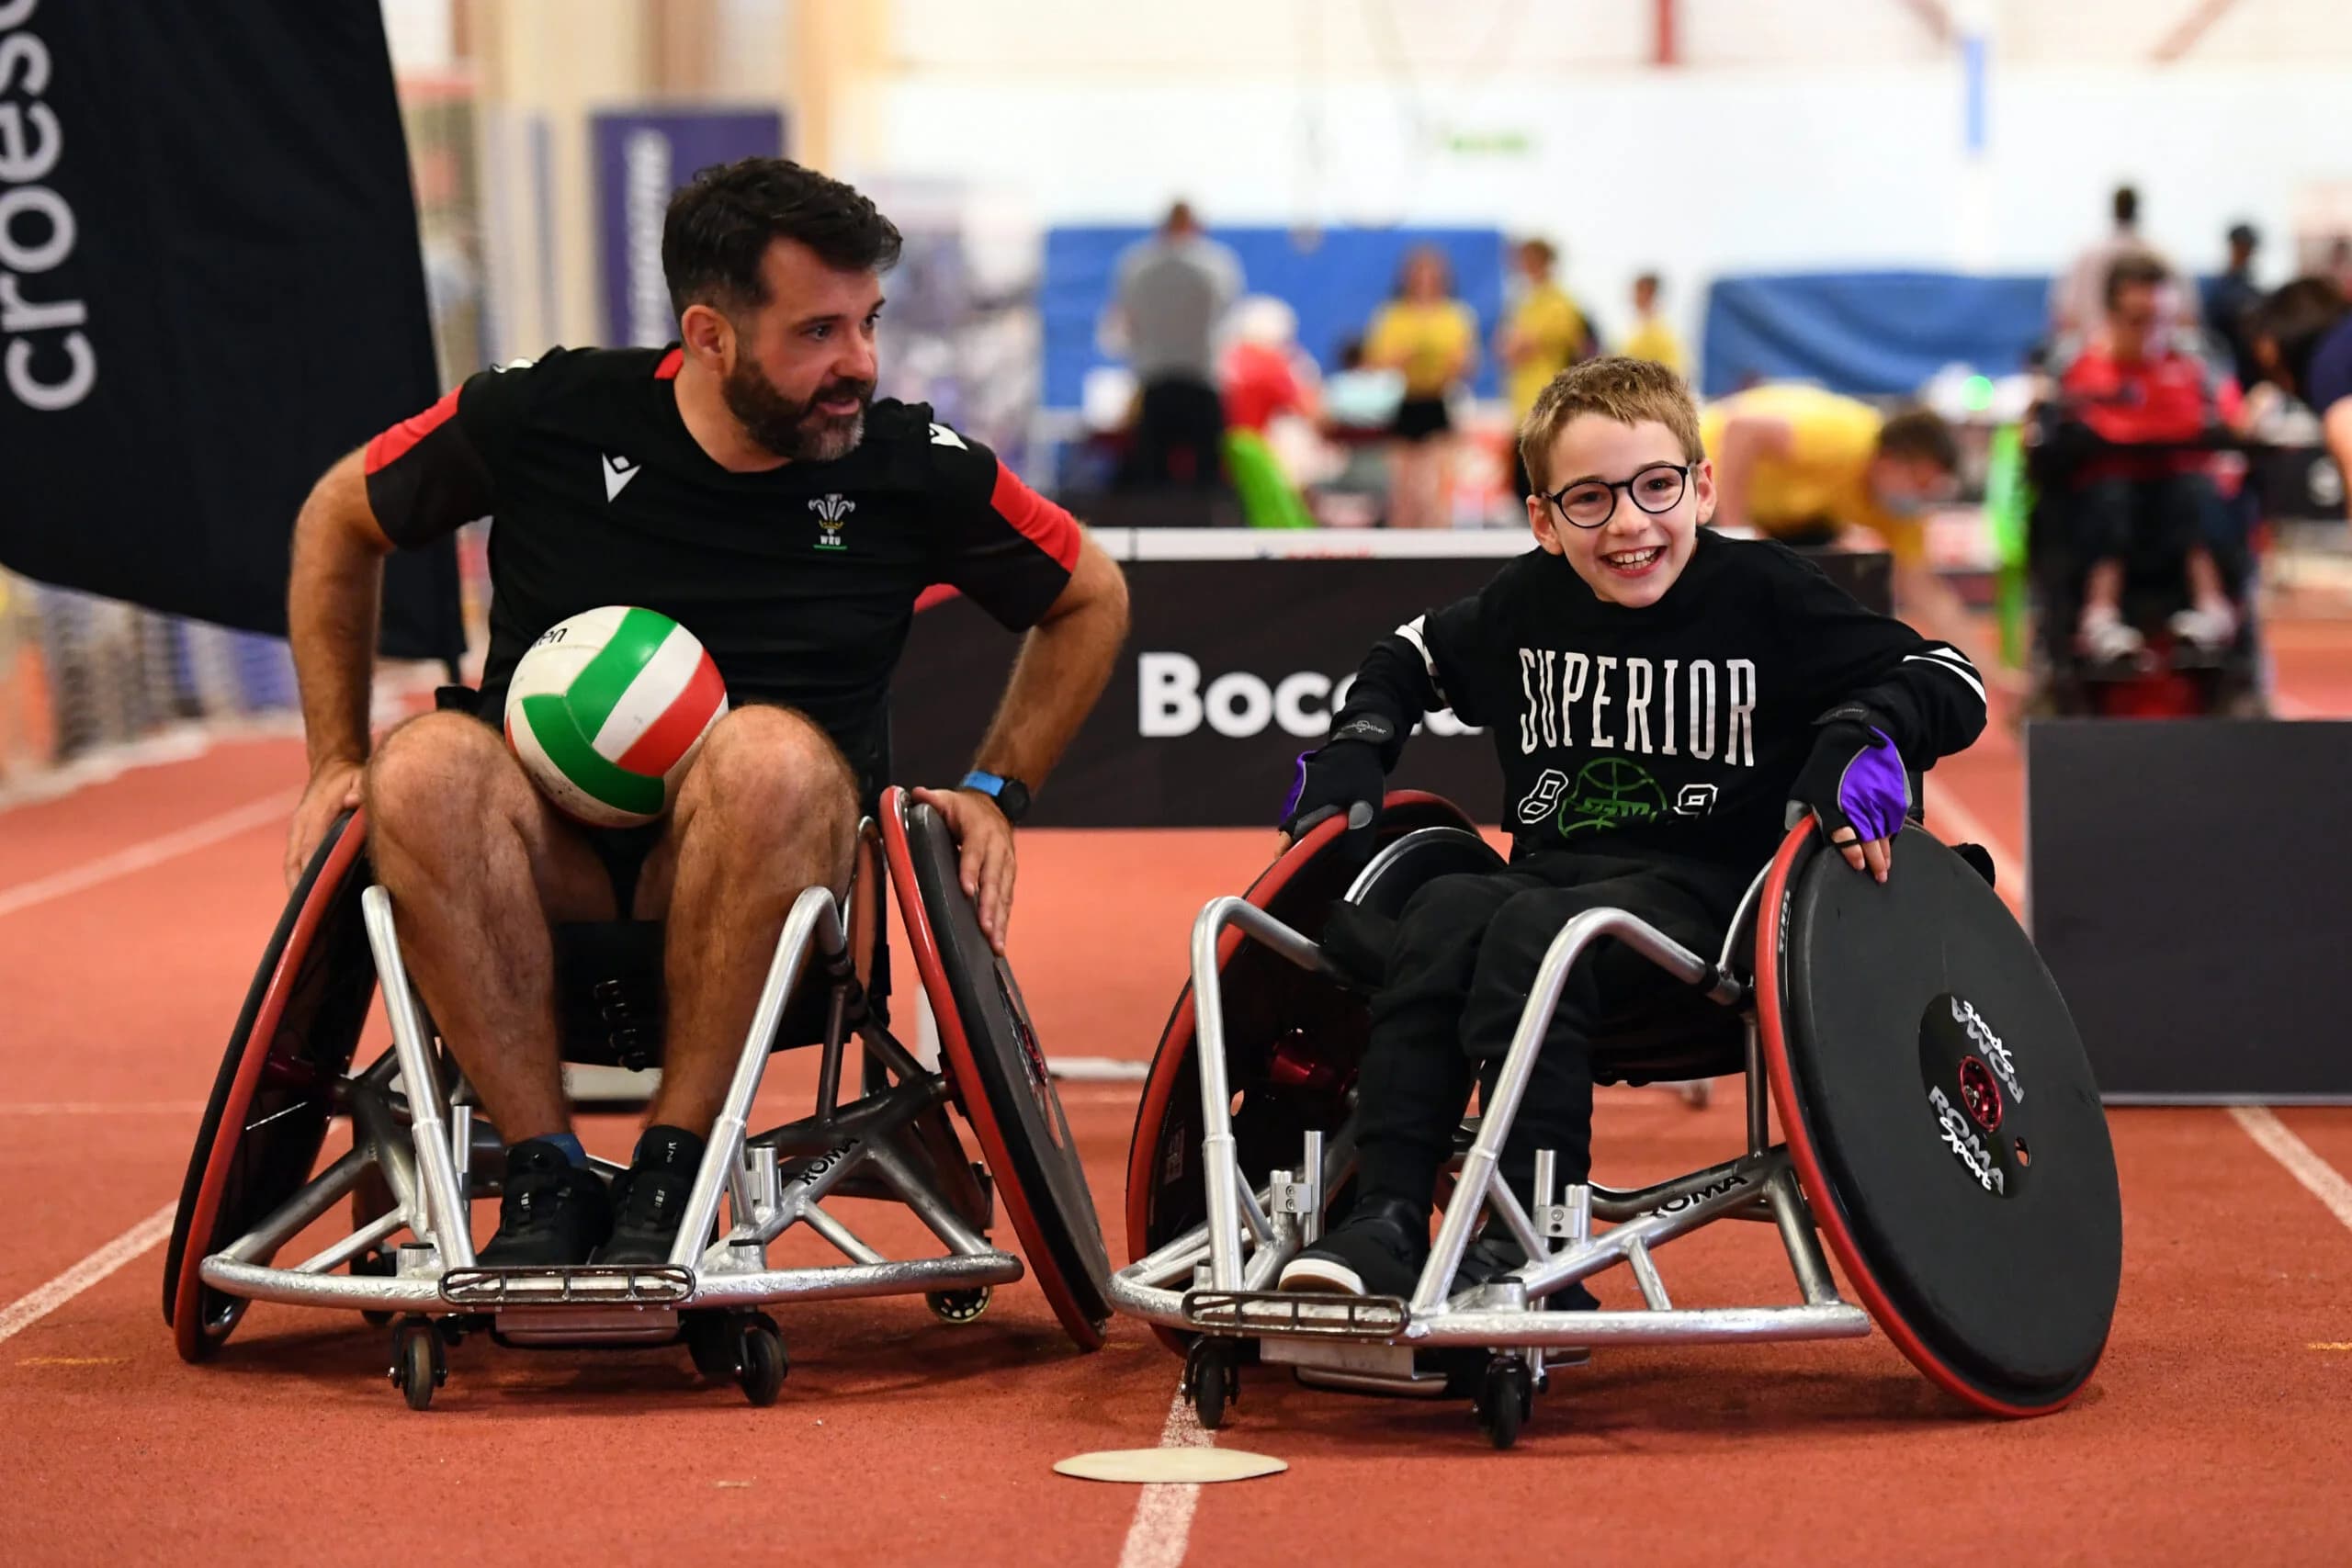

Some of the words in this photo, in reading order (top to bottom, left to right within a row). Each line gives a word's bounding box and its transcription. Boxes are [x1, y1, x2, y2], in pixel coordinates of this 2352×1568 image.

[1519, 648, 1756, 767] SUPERIOR
[1518, 769, 1568, 824] 8
[1950, 996, 2025, 1104] ROMA
[1928, 1085, 2004, 1196] ROMA
